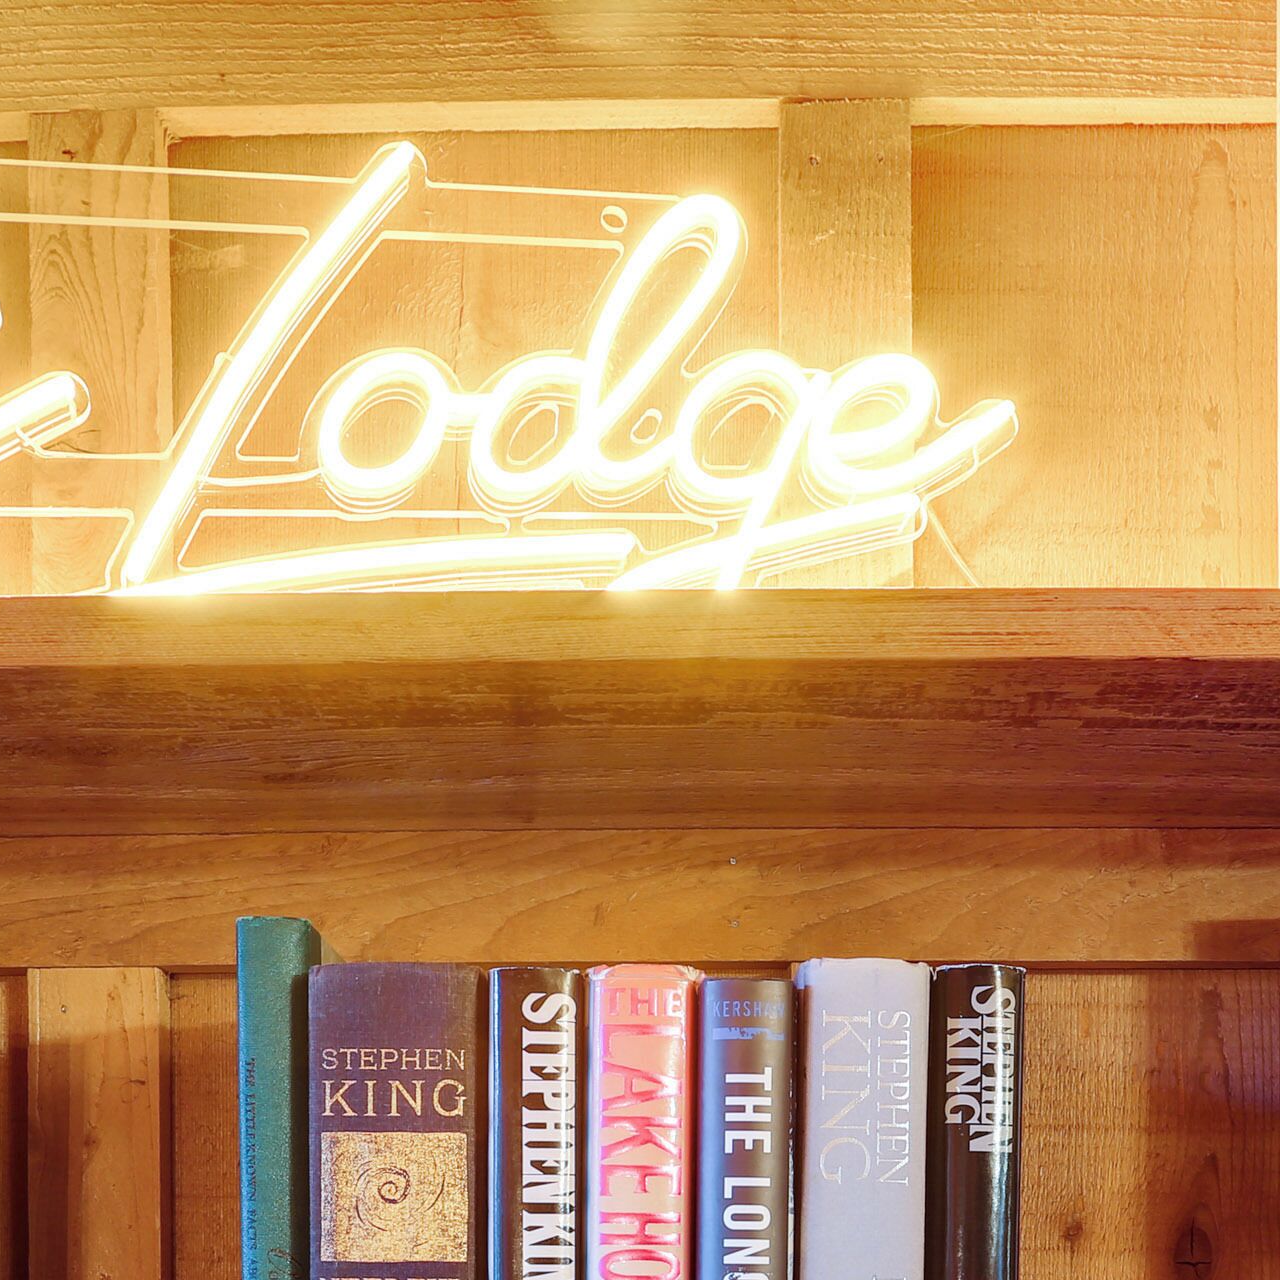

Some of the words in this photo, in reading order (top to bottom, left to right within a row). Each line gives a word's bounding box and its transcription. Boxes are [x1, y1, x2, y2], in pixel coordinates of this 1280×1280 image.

[110, 140, 1018, 596] Lodge
[321, 1049, 465, 1071] STEPHEN
[605, 987, 685, 1017] THE
[712, 1001, 785, 1018] KERSHAW
[945, 1015, 982, 1125] KING
[970, 984, 1016, 1154] STEPHEN
[321, 1079, 467, 1117] KING
[521, 992, 577, 1204] STEPHEN
[599, 1023, 683, 1197] LAKE
[724, 1066, 772, 1154] THE
[820, 1010, 871, 1185] KING
[877, 1010, 911, 1187] STEPHEN
